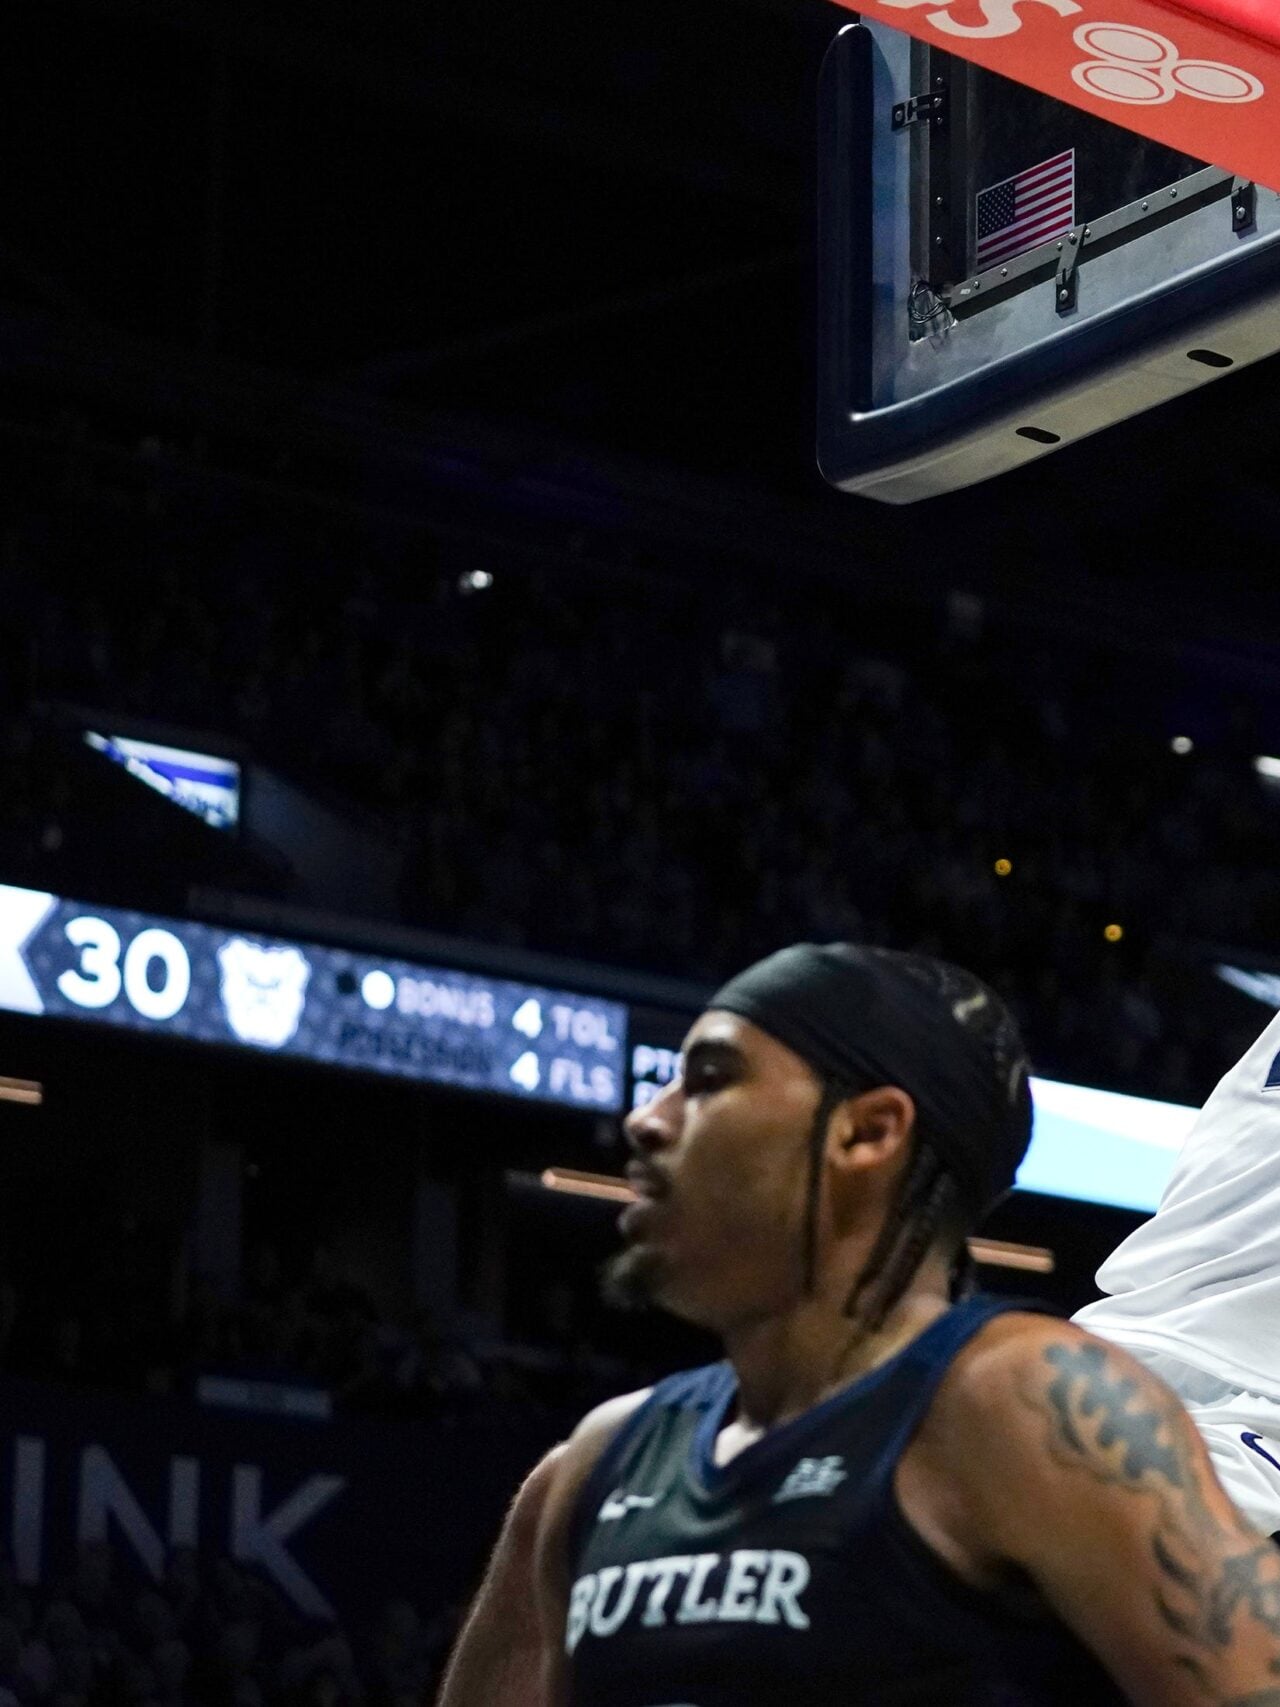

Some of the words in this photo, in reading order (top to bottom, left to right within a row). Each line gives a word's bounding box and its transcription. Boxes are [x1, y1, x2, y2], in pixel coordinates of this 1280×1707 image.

[56, 916, 190, 1020] 30
[396, 976, 495, 1028] BONUS
[512, 998, 543, 1038] 4
[551, 1004, 617, 1051] TOL
[510, 1050, 540, 1091] 4
[550, 1057, 616, 1101] FLS
[565, 1549, 811, 1656] BUTLER
